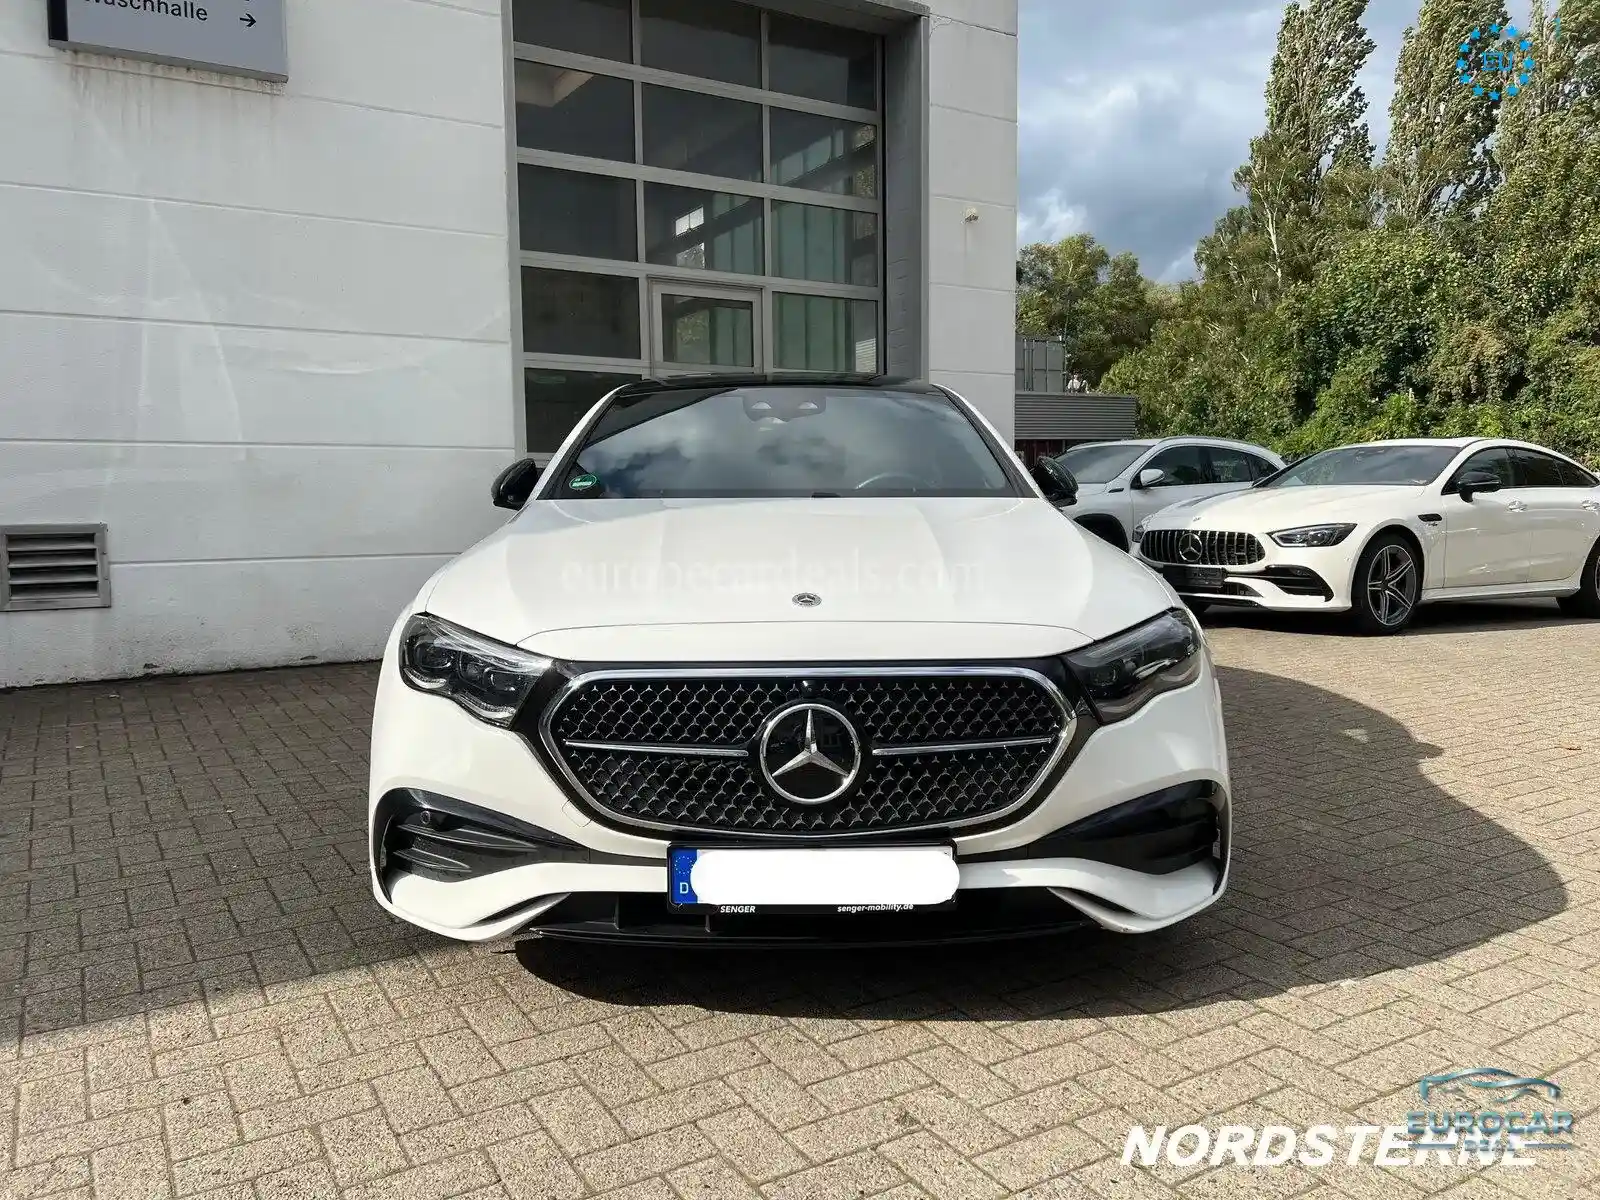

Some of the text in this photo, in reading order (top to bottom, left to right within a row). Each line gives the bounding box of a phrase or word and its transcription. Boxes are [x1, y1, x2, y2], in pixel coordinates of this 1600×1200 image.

[85, 0, 208, 21] schhalle
[679, 882, 689, 894] D
[720, 905, 756, 913] SENGER
[837, 903, 914, 913] senger-mobility.de
